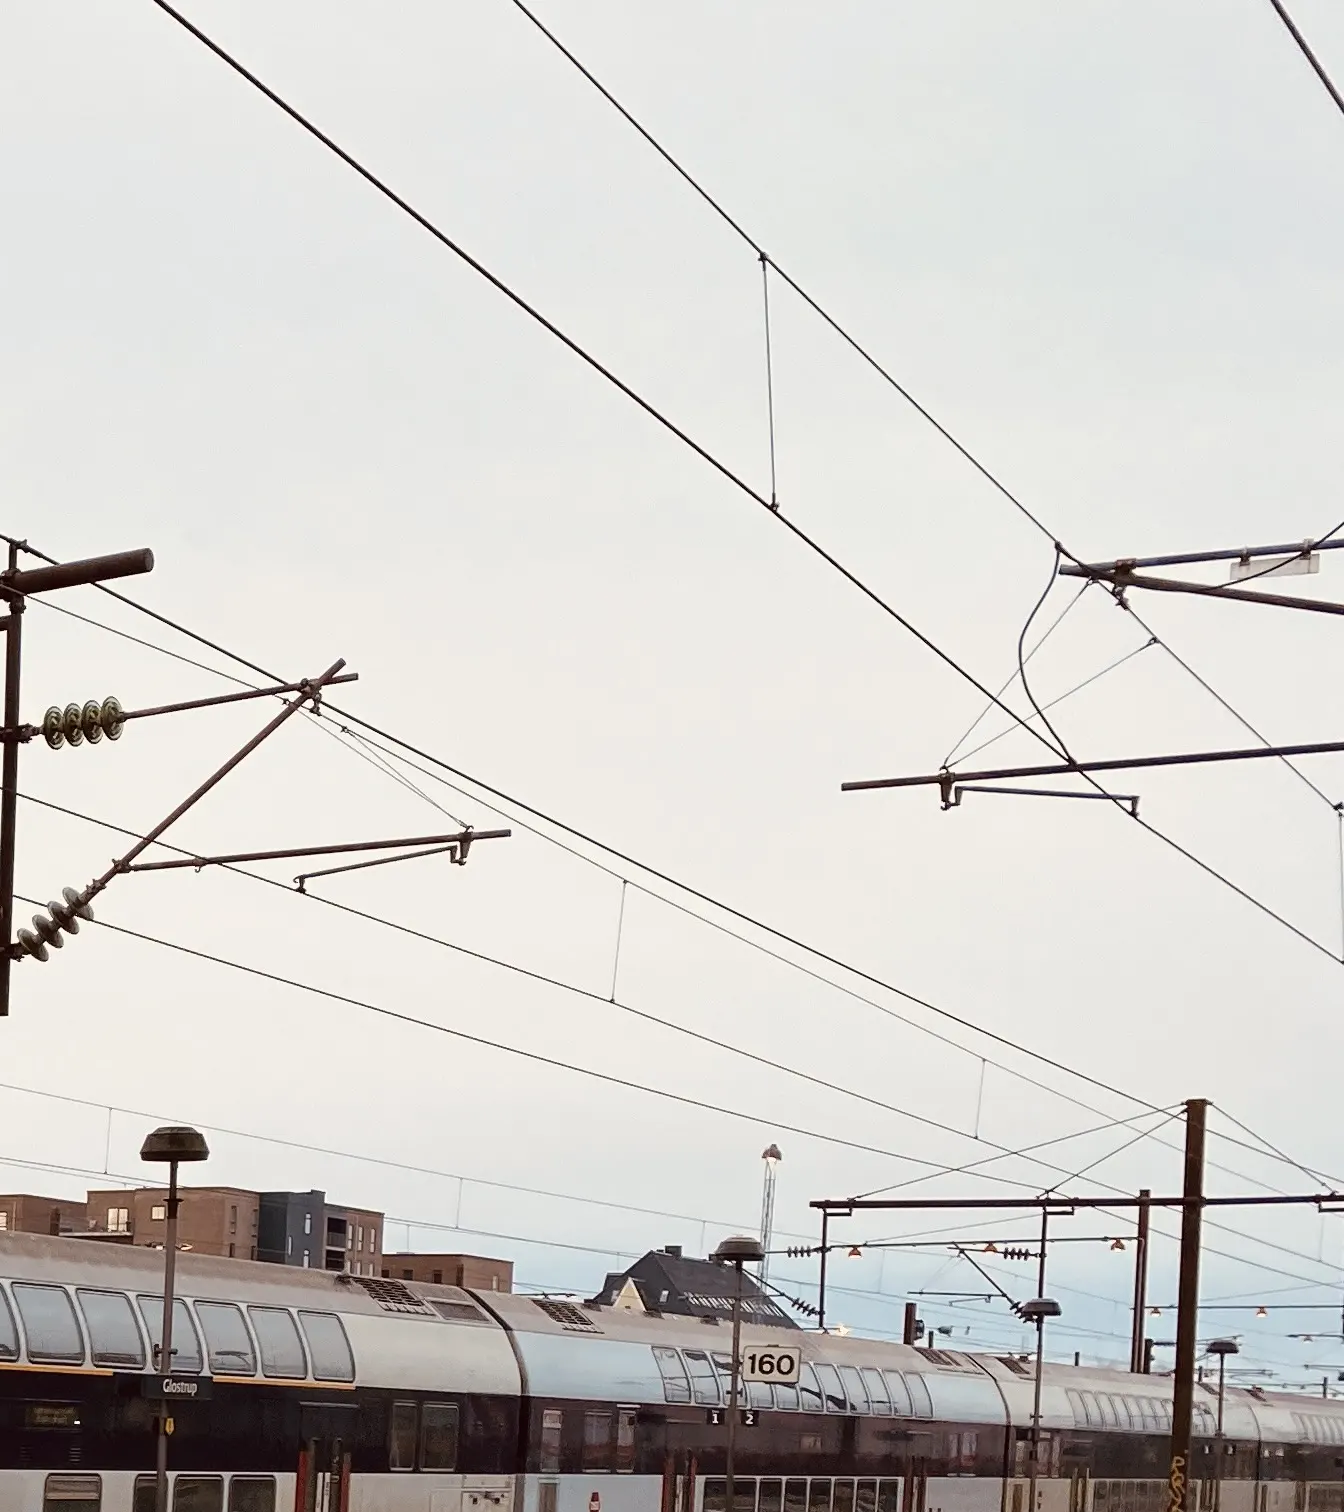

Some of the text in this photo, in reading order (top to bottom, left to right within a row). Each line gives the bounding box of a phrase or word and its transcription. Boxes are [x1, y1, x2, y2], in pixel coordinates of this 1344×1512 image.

[748, 1353, 795, 1375] 160
[162, 1378, 198, 1397] Glostrup
[712, 1413, 719, 1424] 1
[745, 1413, 754, 1425] 2
